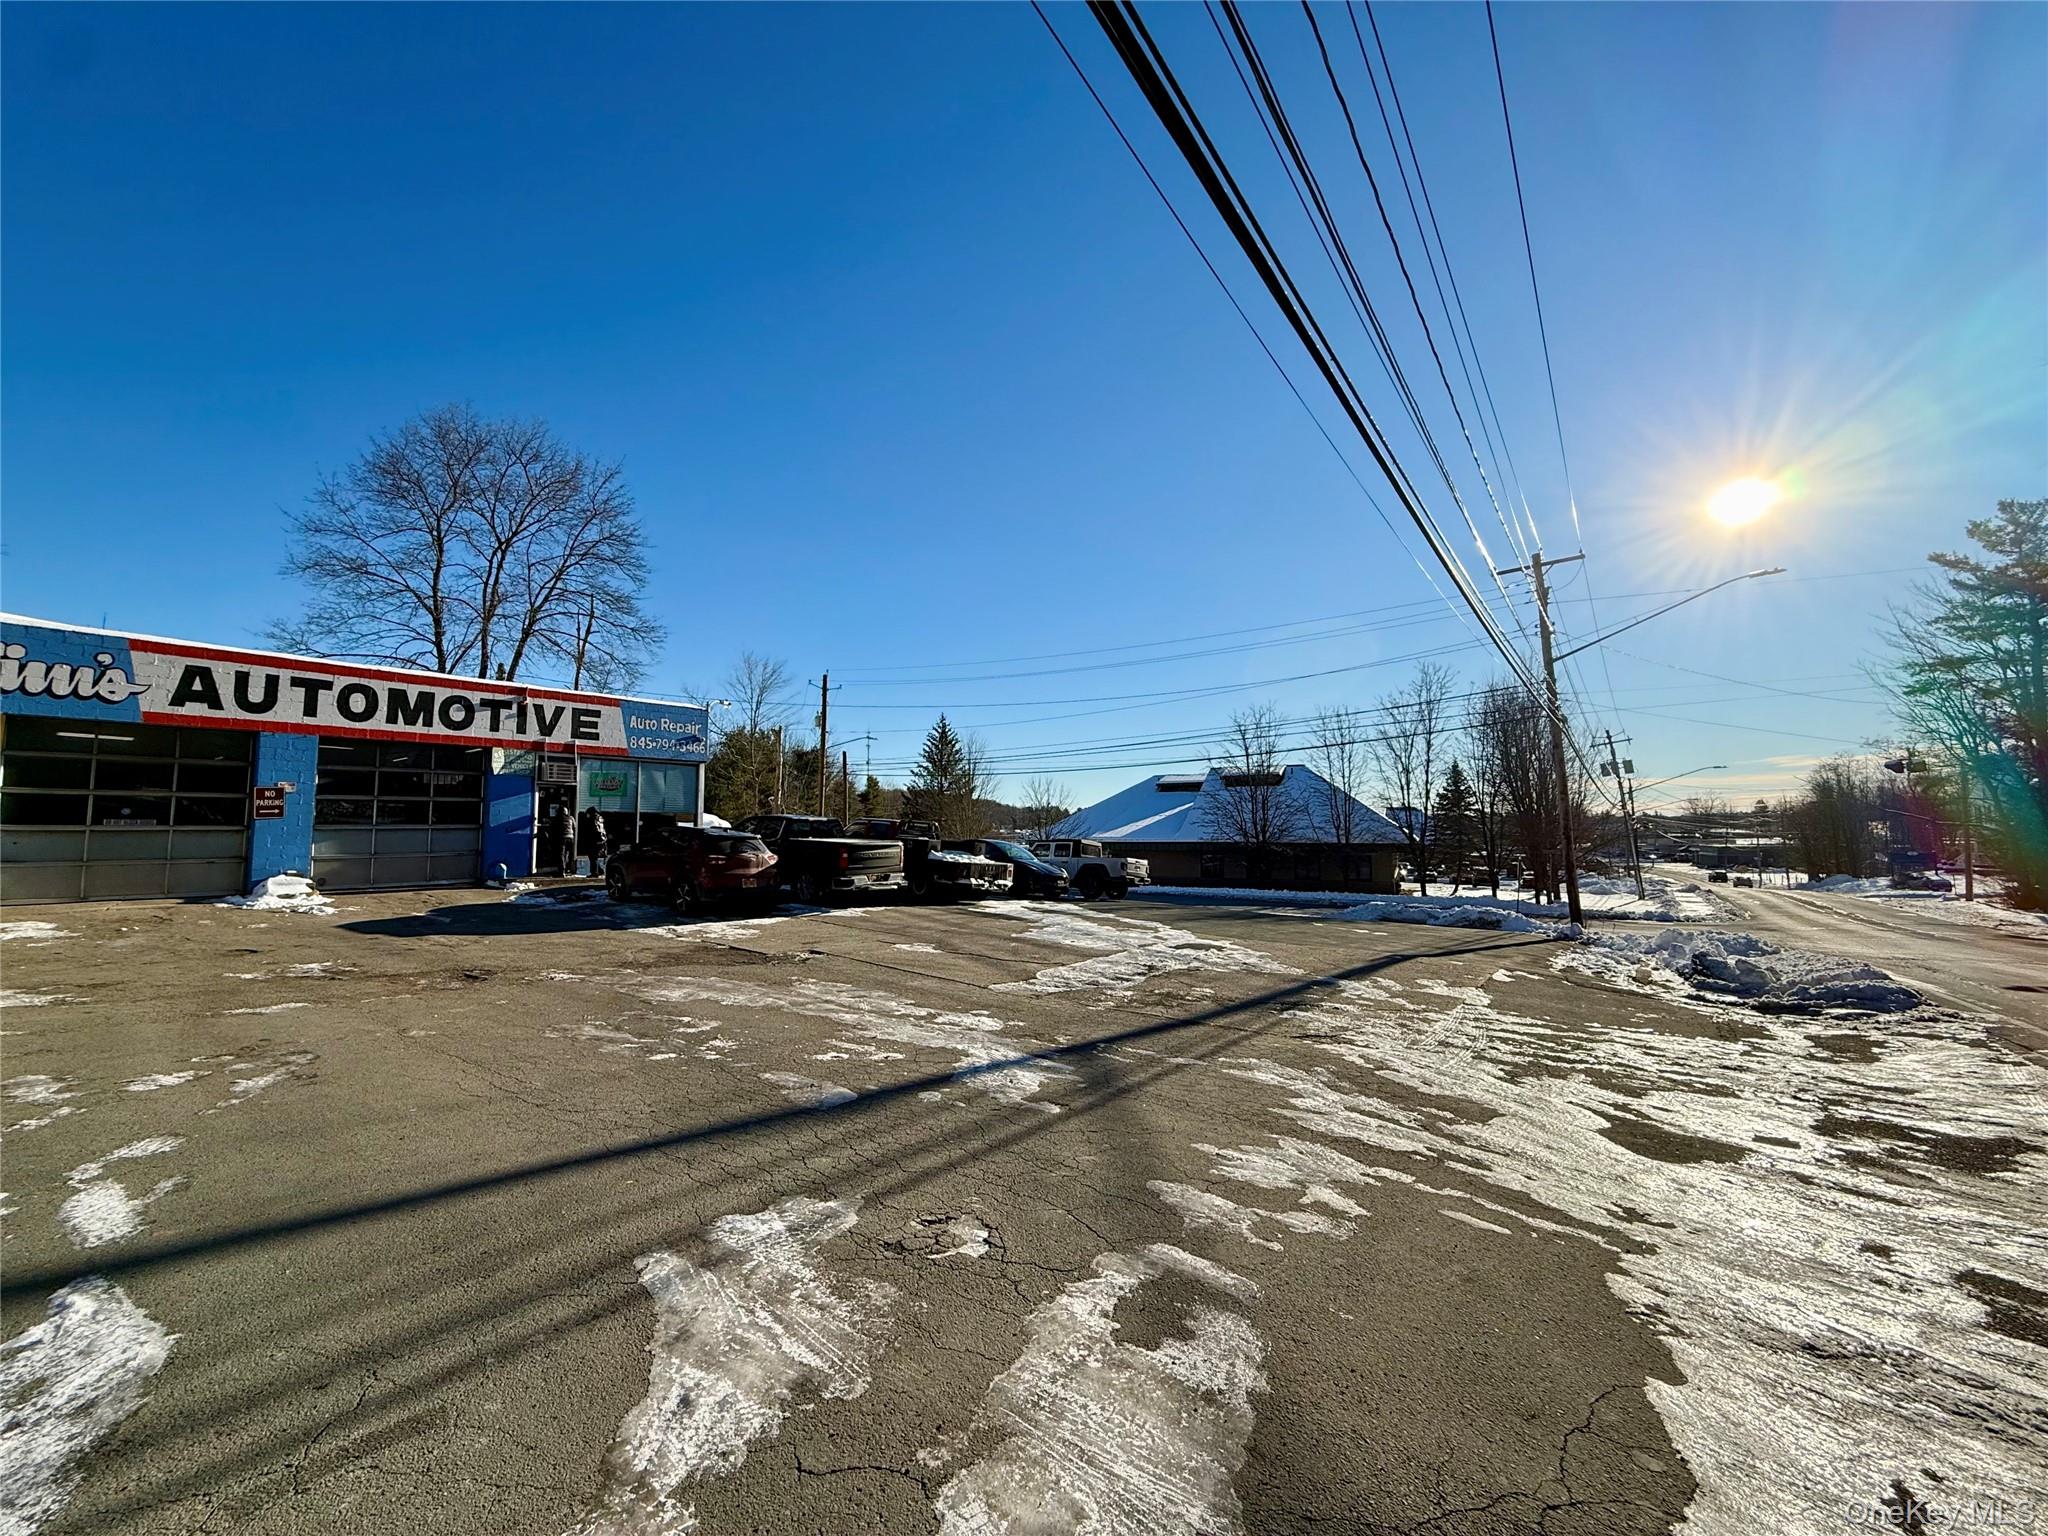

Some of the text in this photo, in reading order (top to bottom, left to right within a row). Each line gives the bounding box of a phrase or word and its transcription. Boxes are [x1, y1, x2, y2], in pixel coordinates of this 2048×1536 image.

[0, 641, 602, 741] im's AUTOMOTIVE
[630, 715, 702, 735] Auto Repair
[264, 790, 276, 798] NO
[256, 799, 284, 807] PARKING
